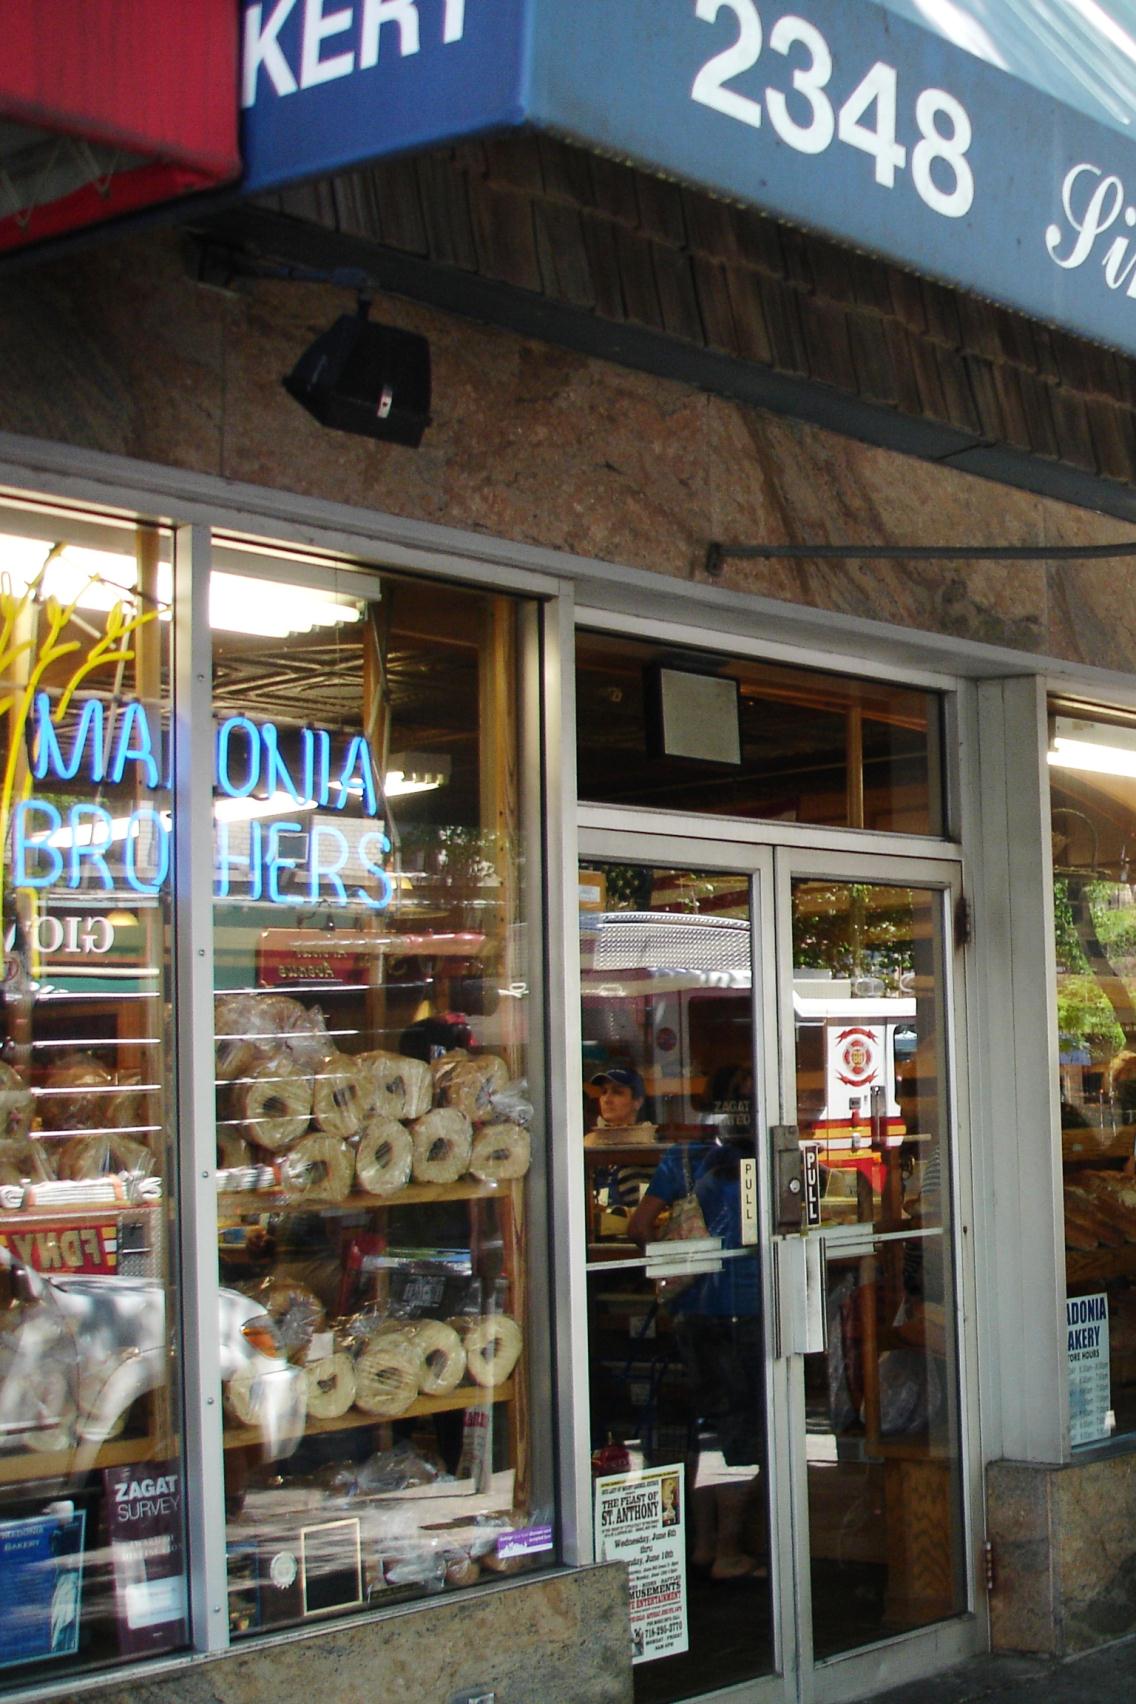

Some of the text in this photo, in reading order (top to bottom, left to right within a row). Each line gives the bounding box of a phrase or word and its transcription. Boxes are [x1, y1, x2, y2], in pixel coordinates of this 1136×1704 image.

[691, 0, 975, 218] 2348
[34, 692, 377, 816] MAONIA
[13, 799, 393, 909] BROHERS
[806, 1152, 818, 1219] PULL
[114, 1475, 178, 1502] ZAGAT
[117, 1496, 181, 1522] SURVEY
[602, 1498, 619, 1510] THE
[620, 1494, 646, 1507] FEAST
[647, 1490, 659, 1501] OF
[601, 1501, 659, 1527] ST. ANTHONY
